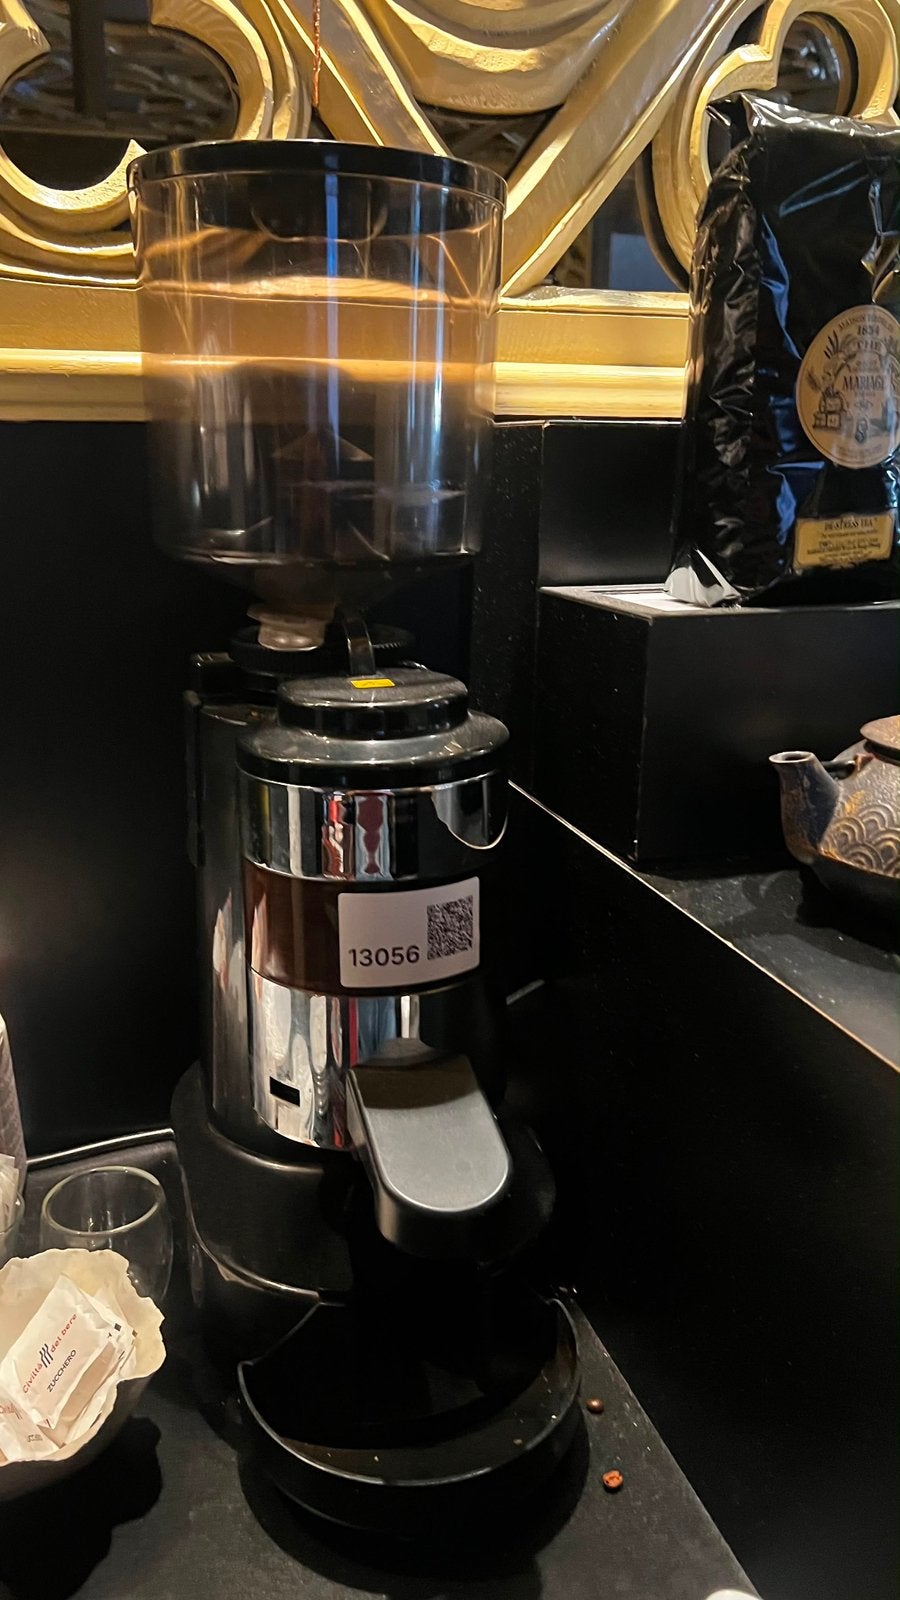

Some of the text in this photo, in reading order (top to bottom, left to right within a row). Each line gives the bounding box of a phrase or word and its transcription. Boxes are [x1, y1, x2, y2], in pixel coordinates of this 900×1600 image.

[348, 945, 420, 967] 13056
[50, 1336, 62, 1353] del
[61, 1314, 77, 1336] bere
[47, 1349, 77, 1393] ZUCCHERO
